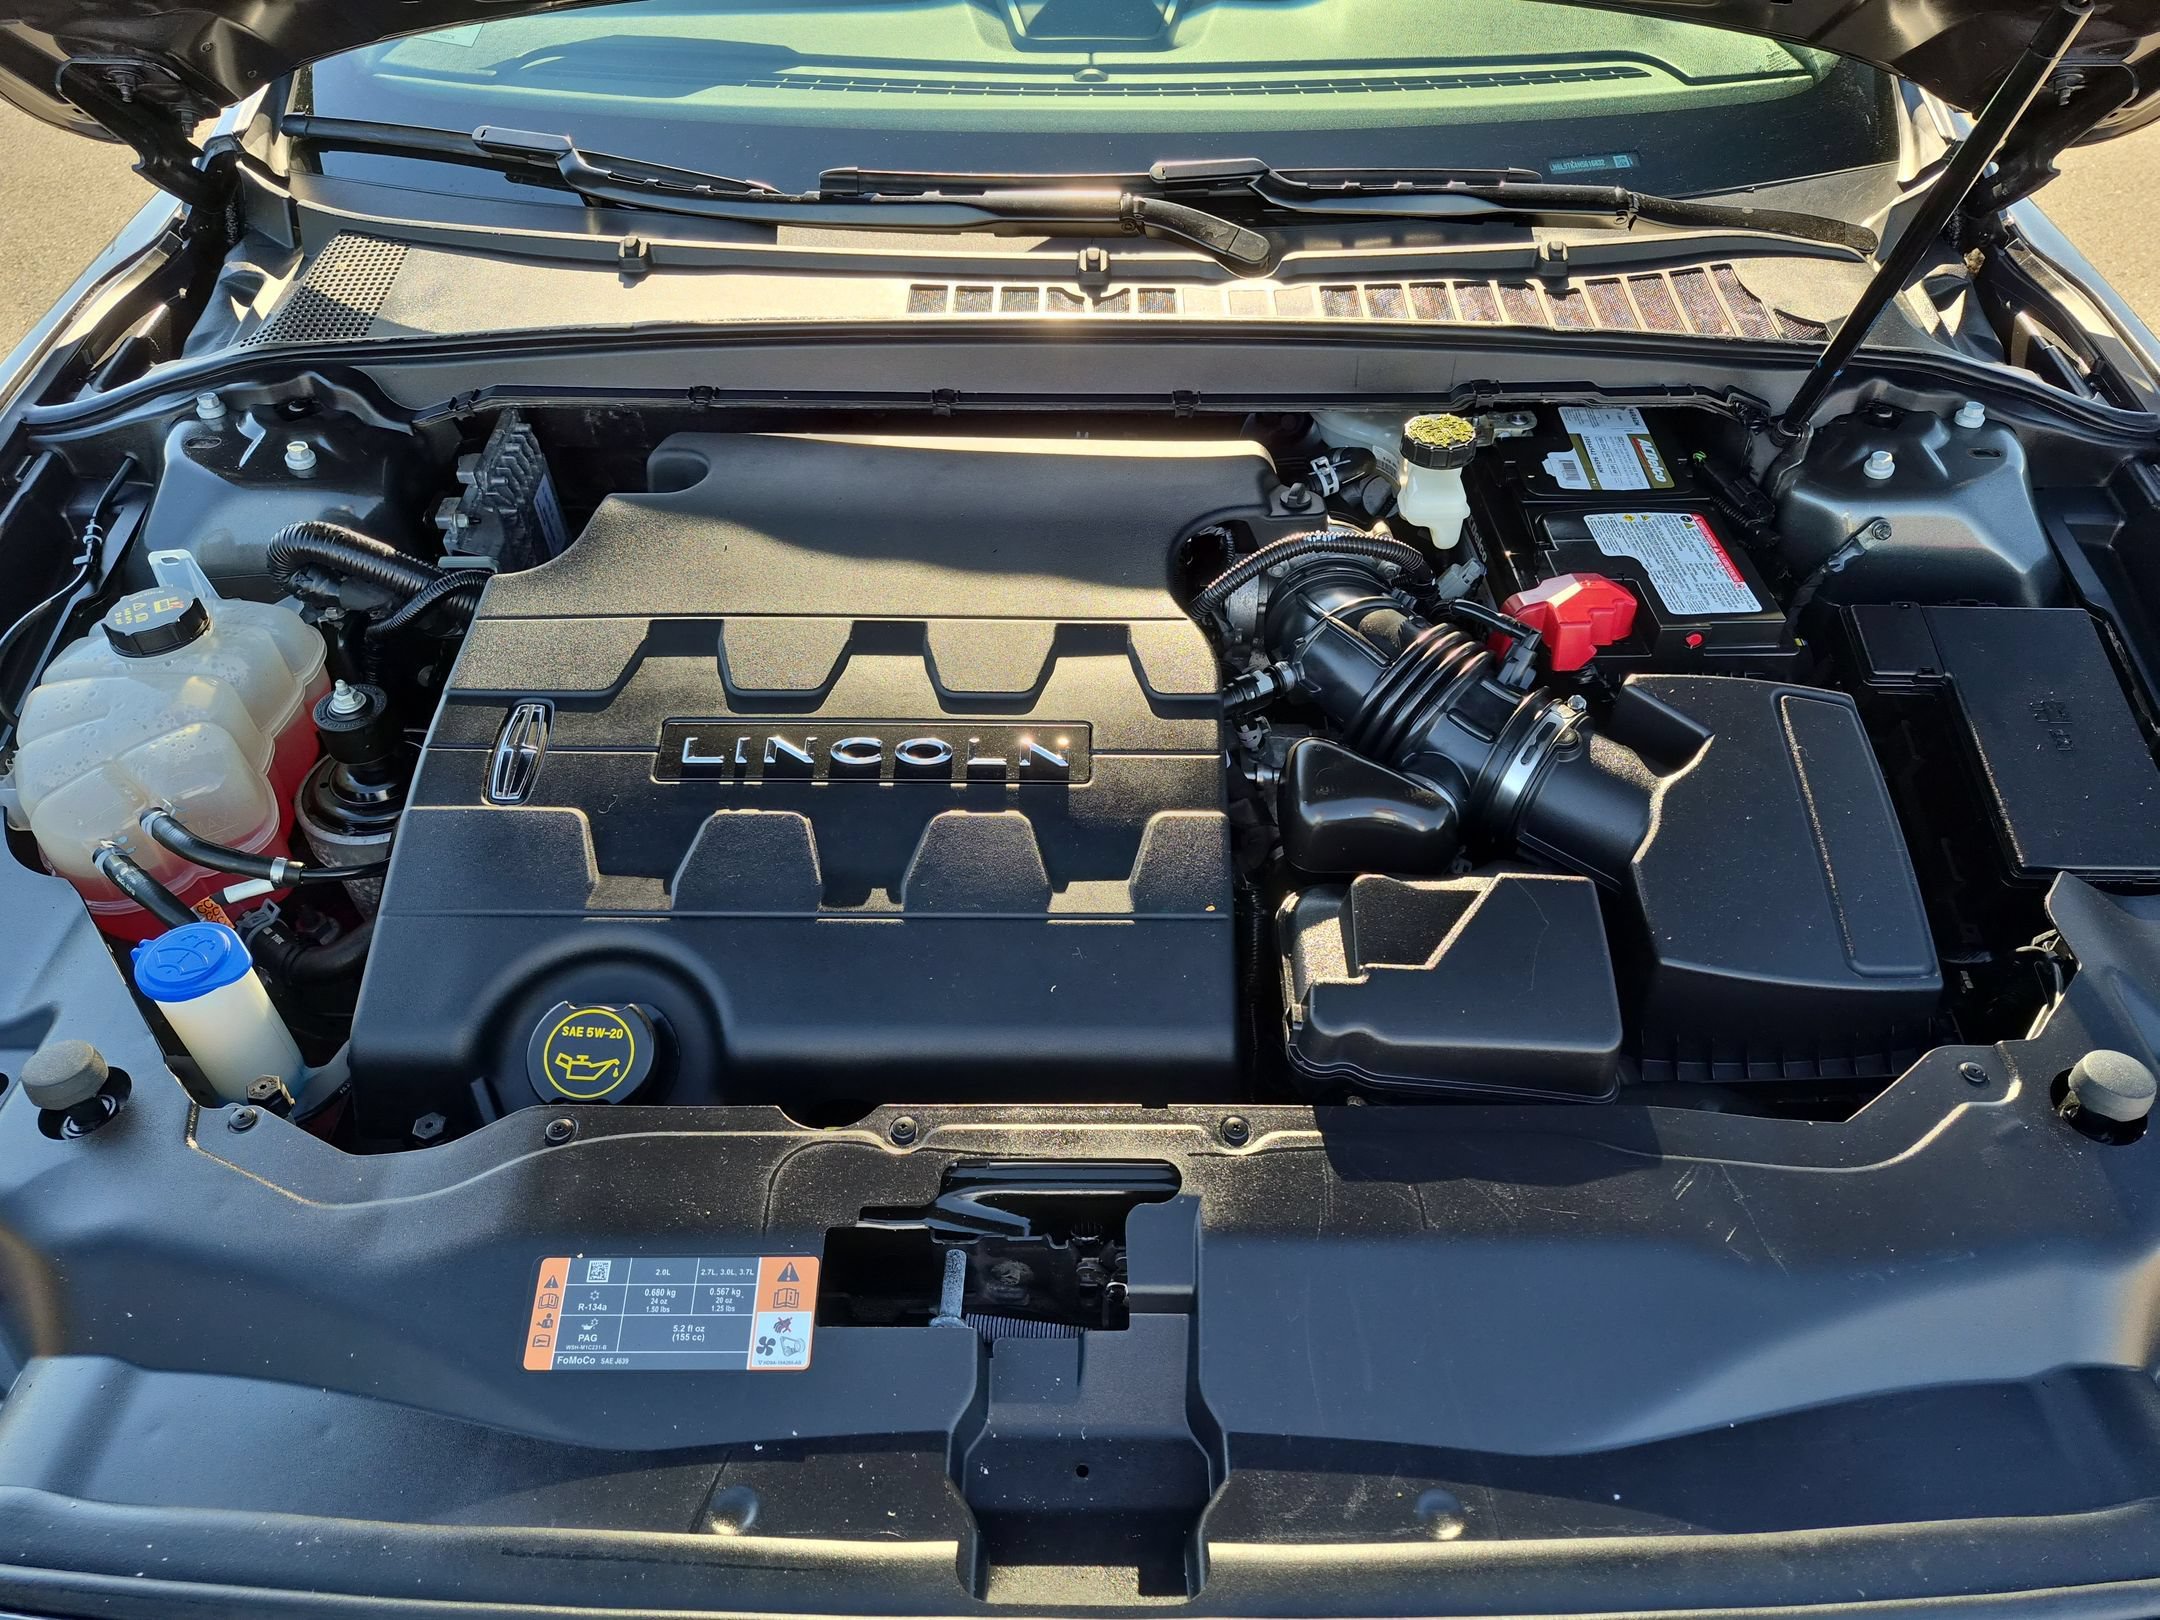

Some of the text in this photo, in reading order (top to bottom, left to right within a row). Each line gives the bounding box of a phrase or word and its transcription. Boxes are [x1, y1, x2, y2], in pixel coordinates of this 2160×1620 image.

[1637, 438, 1667, 483] ACDelco
[681, 736, 1070, 767] LINCOLN
[561, 1025, 624, 1040] SAE 5W-20
[655, 1268, 671, 1276] 2.0L
[739, 1268, 755, 1276] 3.7L
[644, 1288, 677, 1298] 0.680 kg
[709, 1287, 742, 1298] 0.567 kg
[650, 1297, 659, 1305] 24
[715, 1296, 724, 1304] 20
[577, 1302, 608, 1311] R-134a
[646, 1305, 671, 1313] 1.50 lbs
[711, 1304, 736, 1312] 1.25 lbs
[672, 1324, 706, 1333] 5.2 fl oz
[577, 1333, 598, 1343] PAG
[671, 1333, 705, 1343] (155 cc)
[556, 1355, 596, 1365] FoMoCo
[600, 1357, 614, 1365] SAE
